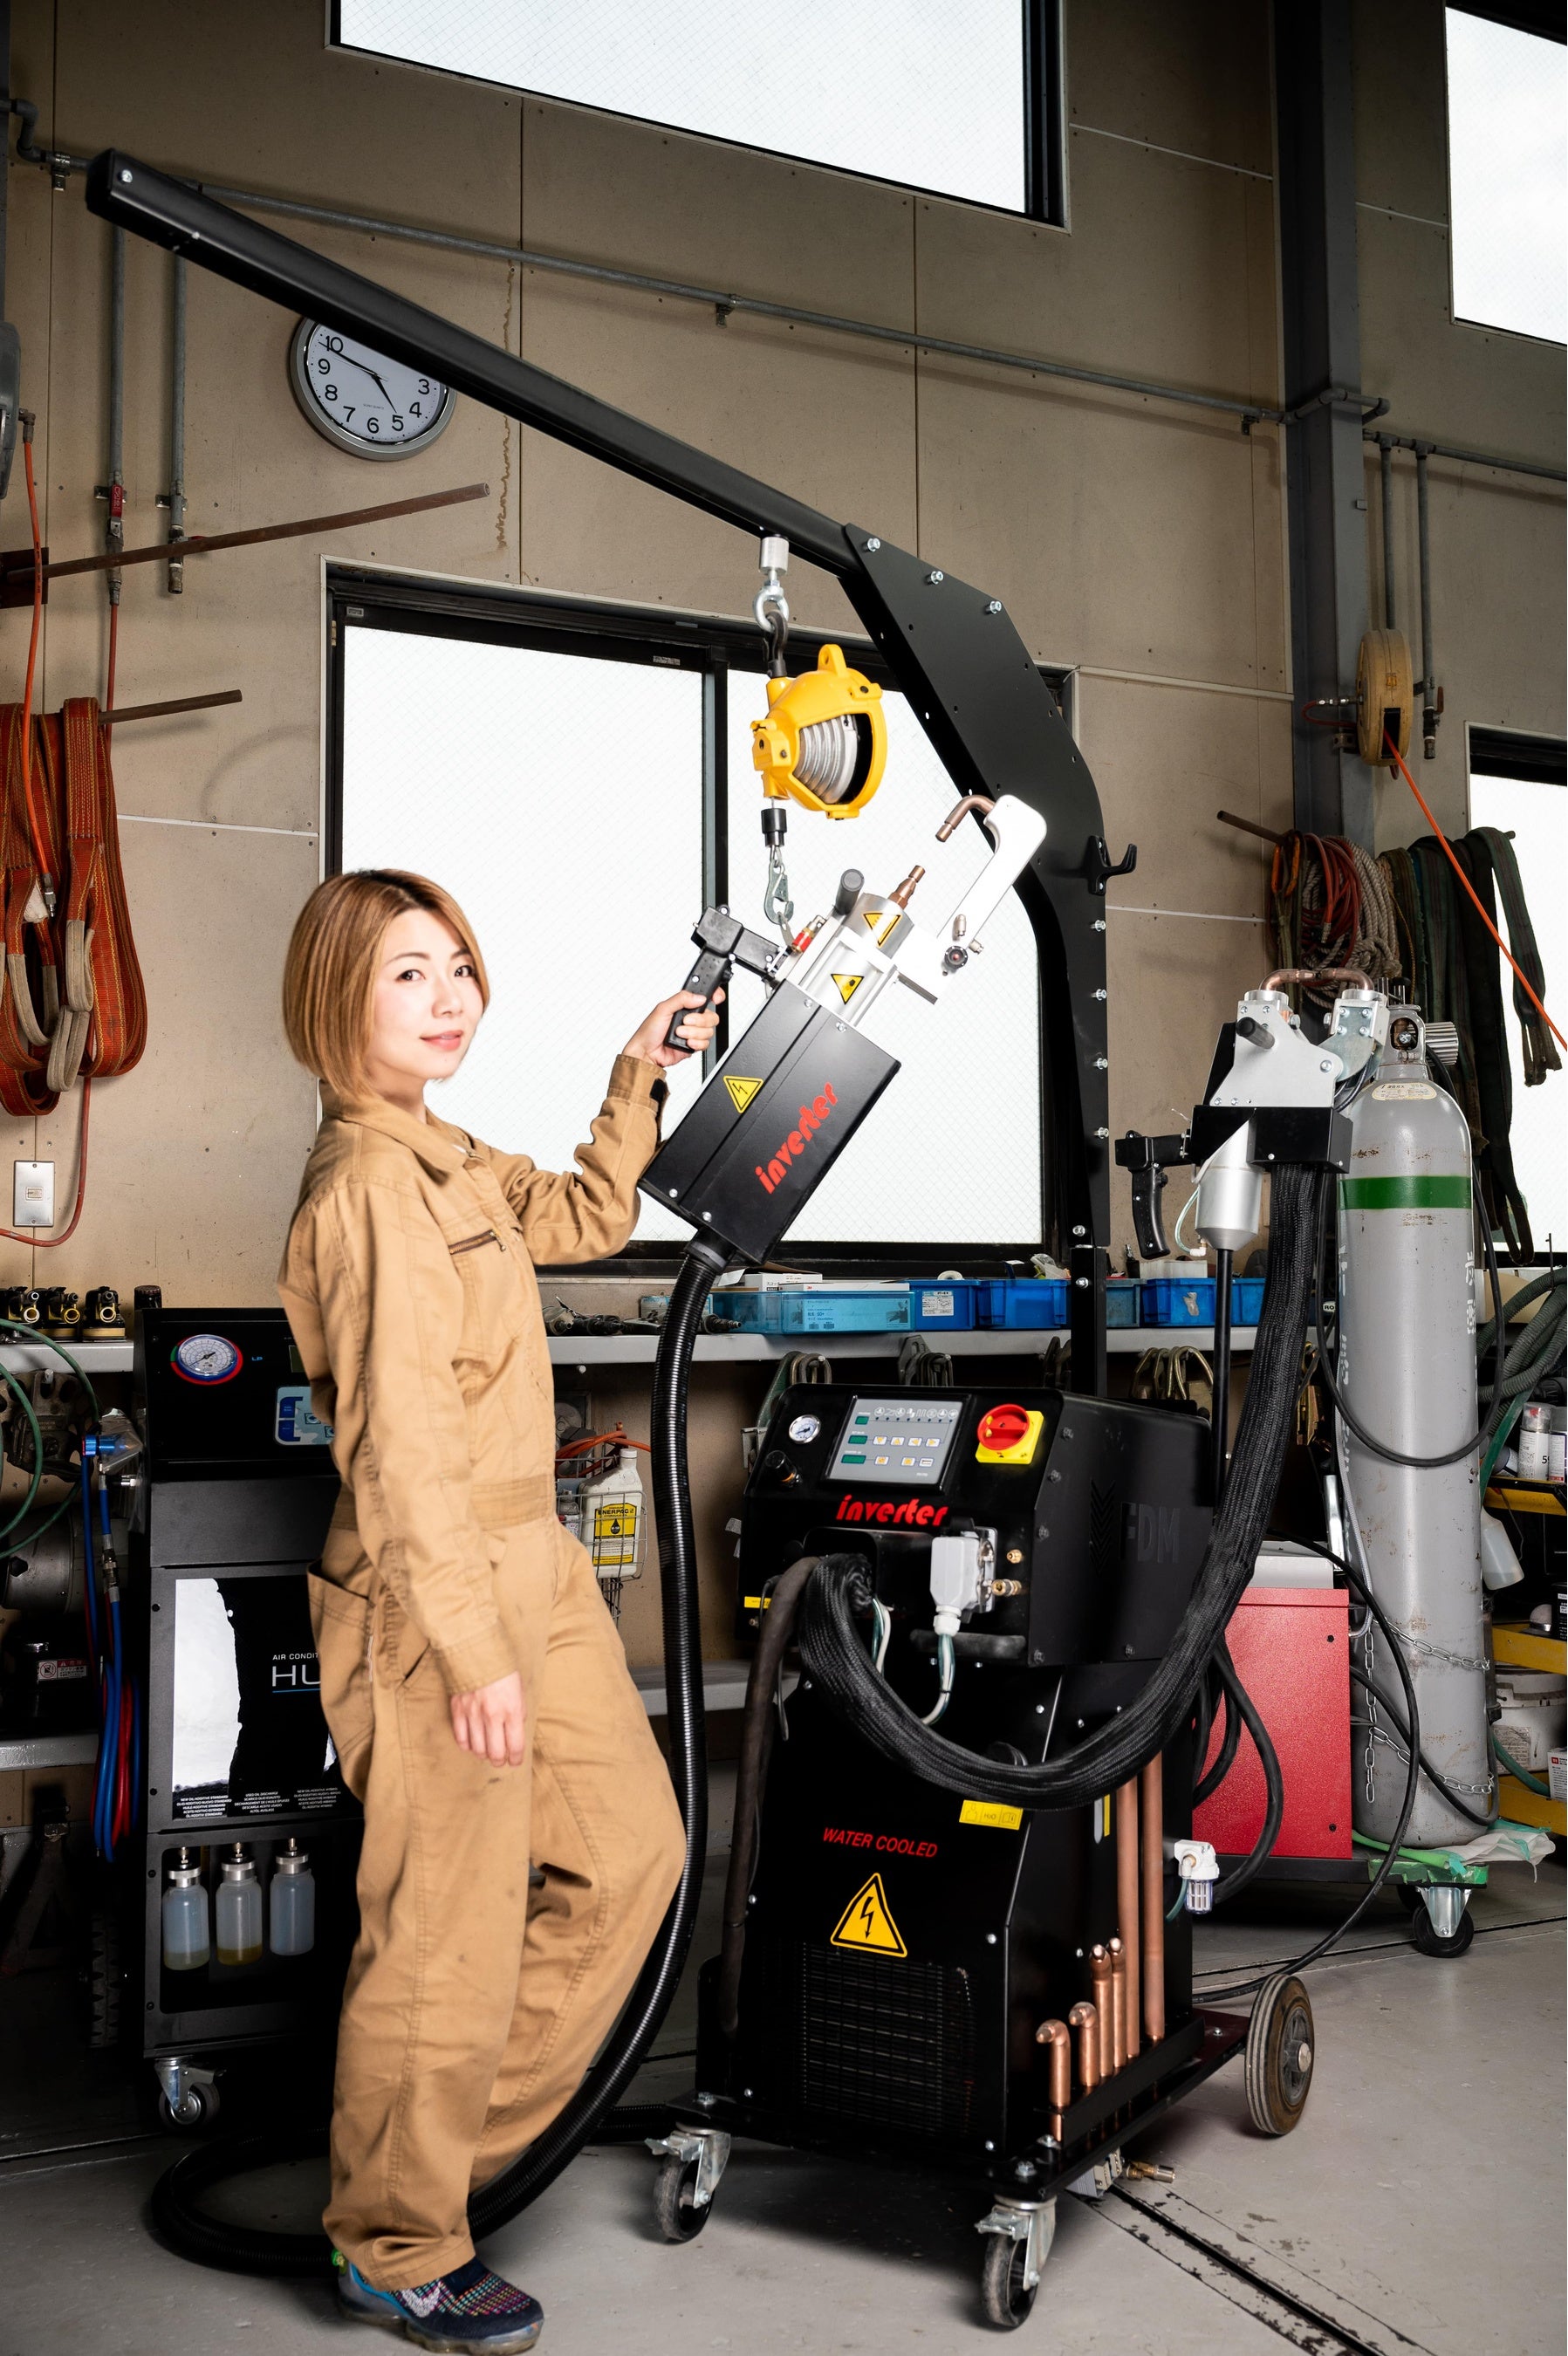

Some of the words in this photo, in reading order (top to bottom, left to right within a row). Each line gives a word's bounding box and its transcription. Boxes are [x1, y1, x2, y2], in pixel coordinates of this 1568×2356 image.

[325, 336, 344, 353] 10
[318, 359, 330, 374] 9
[325, 385, 338, 401] 8
[418, 379, 430, 394] 3
[343, 406, 356, 422] 7
[409, 402, 421, 418] 4
[367, 417, 379, 434] 6
[392, 414, 403, 431] 5
[755, 1082, 838, 1194] inverter
[836, 1494, 948, 1526] inverter
[1119, 1501, 1180, 1564] FDM
[823, 1827, 873, 1848] WATER
[876, 1836, 938, 1858] COOLED
